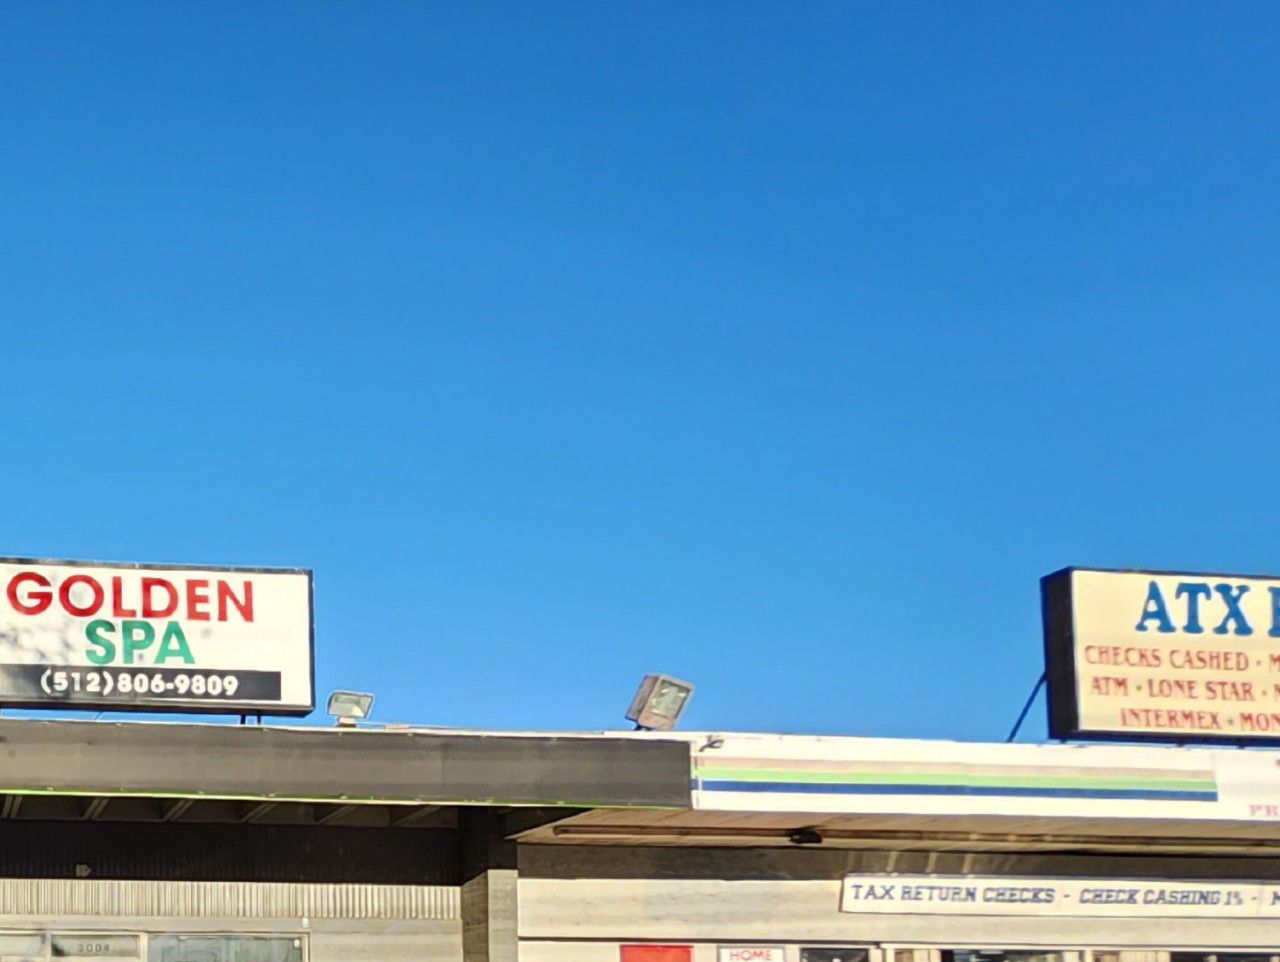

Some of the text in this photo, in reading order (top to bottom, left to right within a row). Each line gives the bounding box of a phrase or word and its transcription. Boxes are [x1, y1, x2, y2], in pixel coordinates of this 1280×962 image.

[6, 571, 254, 623] GOLDEN
[1135, 580, 1253, 636] ATX
[85, 619, 195, 665] SPA
[1084, 645, 1162, 668] CHECKS
[1169, 650, 1249, 672] CASHED
[40, 668, 239, 697] (512)806-9809
[1091, 676, 1128, 697] ATM
[1147, 679, 1199, 699] LONE
[1205, 681, 1255, 702] STAR
[1120, 708, 1223, 730] INTERMEX
[851, 883, 894, 901] TAX
[900, 885, 977, 903] RETURN
[982, 886, 1056, 905] CHECKS
[1078, 888, 1141, 906] CHECK
[1142, 889, 1221, 907] CASHING
[730, 950, 773, 962] HOME
